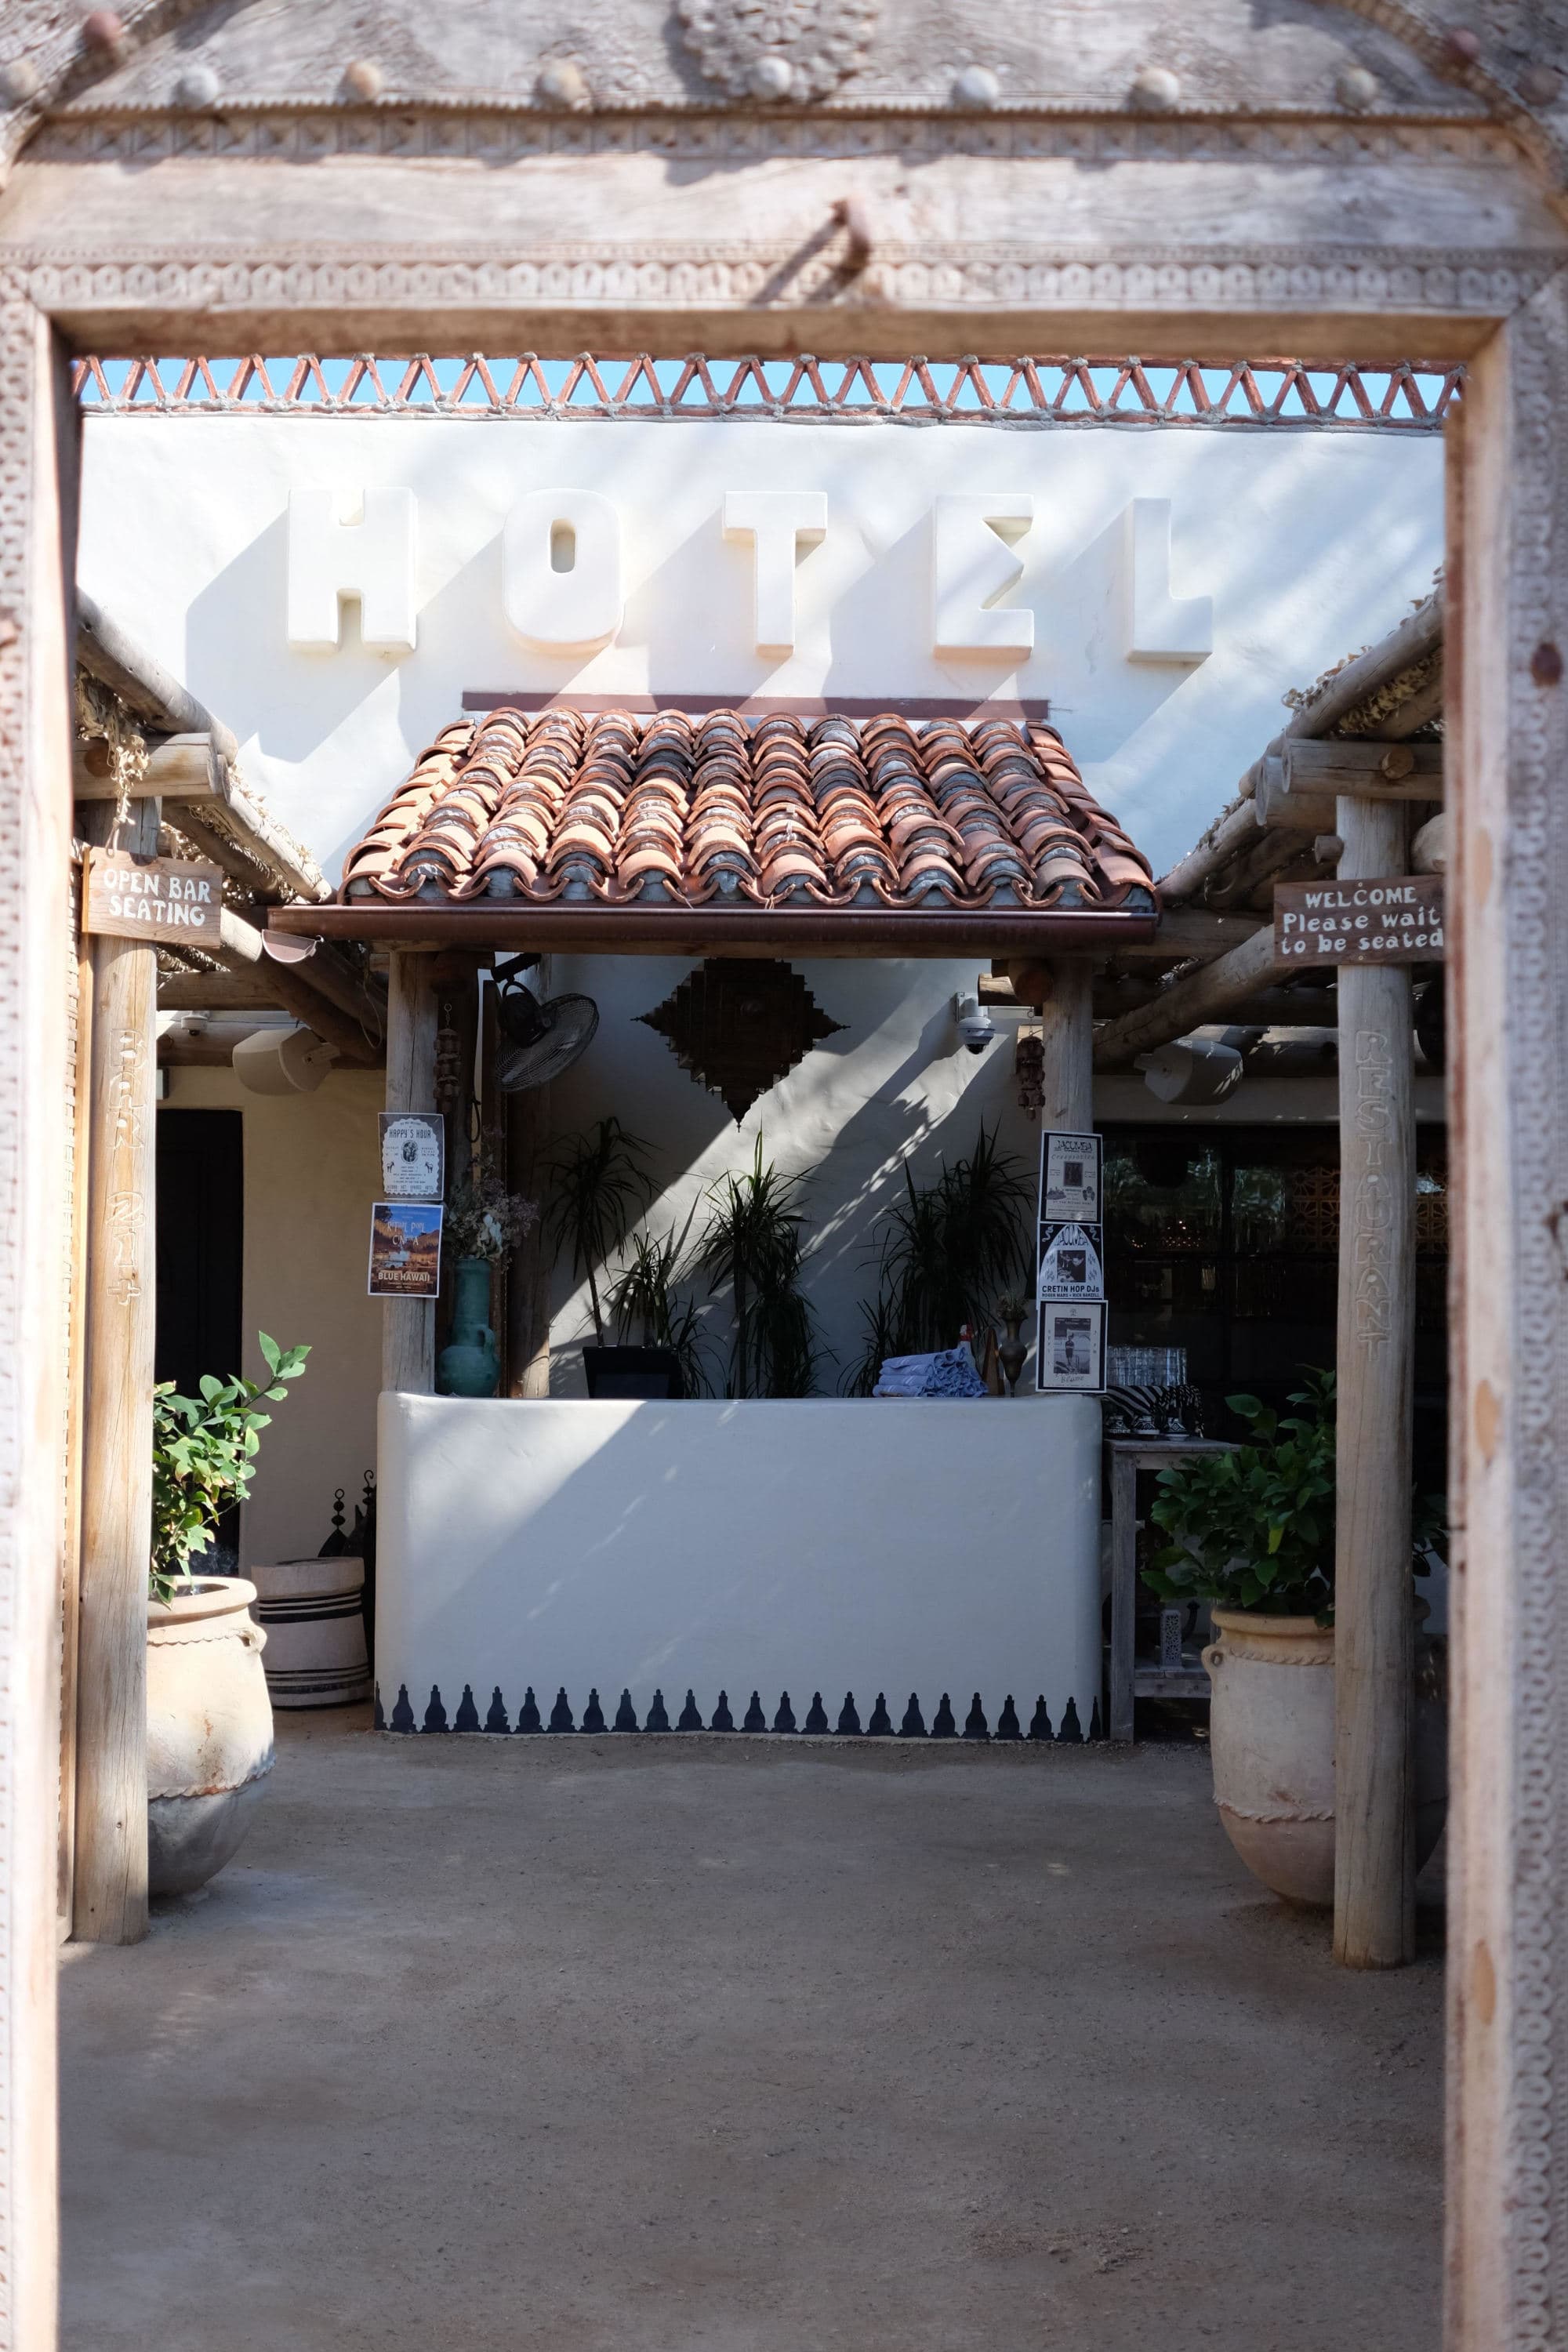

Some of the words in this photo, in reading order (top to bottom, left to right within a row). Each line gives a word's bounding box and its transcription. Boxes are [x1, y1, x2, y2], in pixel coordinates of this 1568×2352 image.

[287, 487, 1214, 662] HOTEL
[103, 869, 159, 896] OPEN
[169, 877, 211, 903] BAR
[1305, 887, 1417, 909] WELCOME
[108, 895, 205, 927] SEATING
[1283, 913, 1369, 933] Please
[1381, 906, 1441, 927] wait
[1281, 937, 1306, 954] to
[1318, 934, 1347, 953] be
[1358, 928, 1443, 950] seated
[107, 1029, 147, 1149] BAR
[389, 1128, 415, 1139] HAPPY'S
[416, 1128, 431, 1139] HOUR
[1355, 1030, 1393, 1363] RESTAURANT
[378, 1272, 398, 1281] BLUE
[400, 1272, 430, 1282] HAWAII
